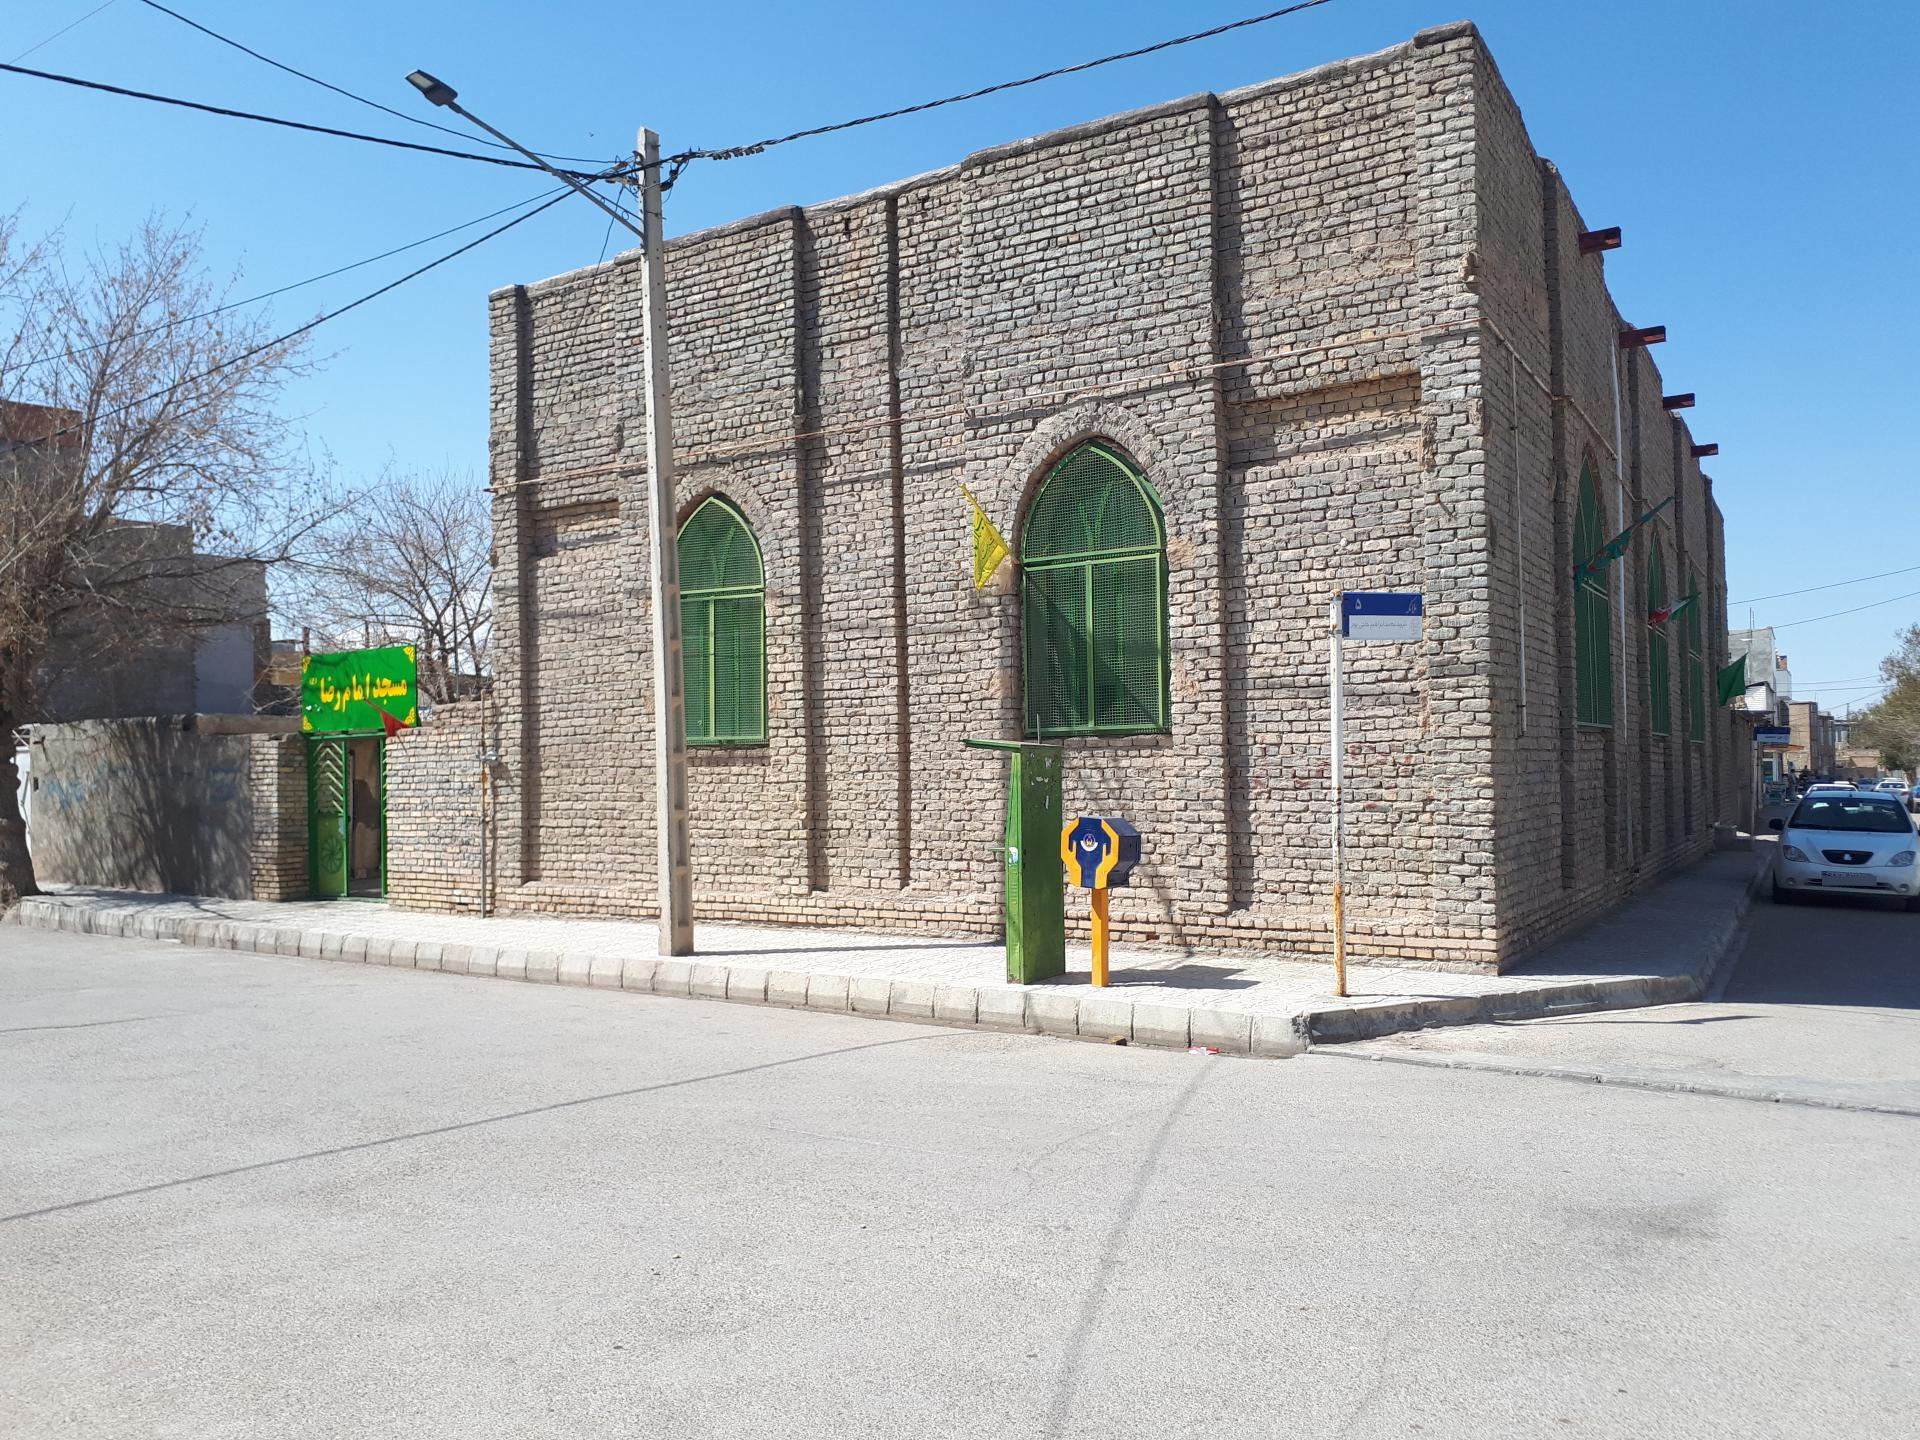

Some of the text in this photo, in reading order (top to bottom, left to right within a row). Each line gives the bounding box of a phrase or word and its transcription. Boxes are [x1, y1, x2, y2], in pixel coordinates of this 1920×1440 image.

[1355, 597, 1362, 610] ۵
[320, 676, 341, 711] رضا
[342, 673, 371, 712] امام
[373, 676, 407, 705] مسجد
